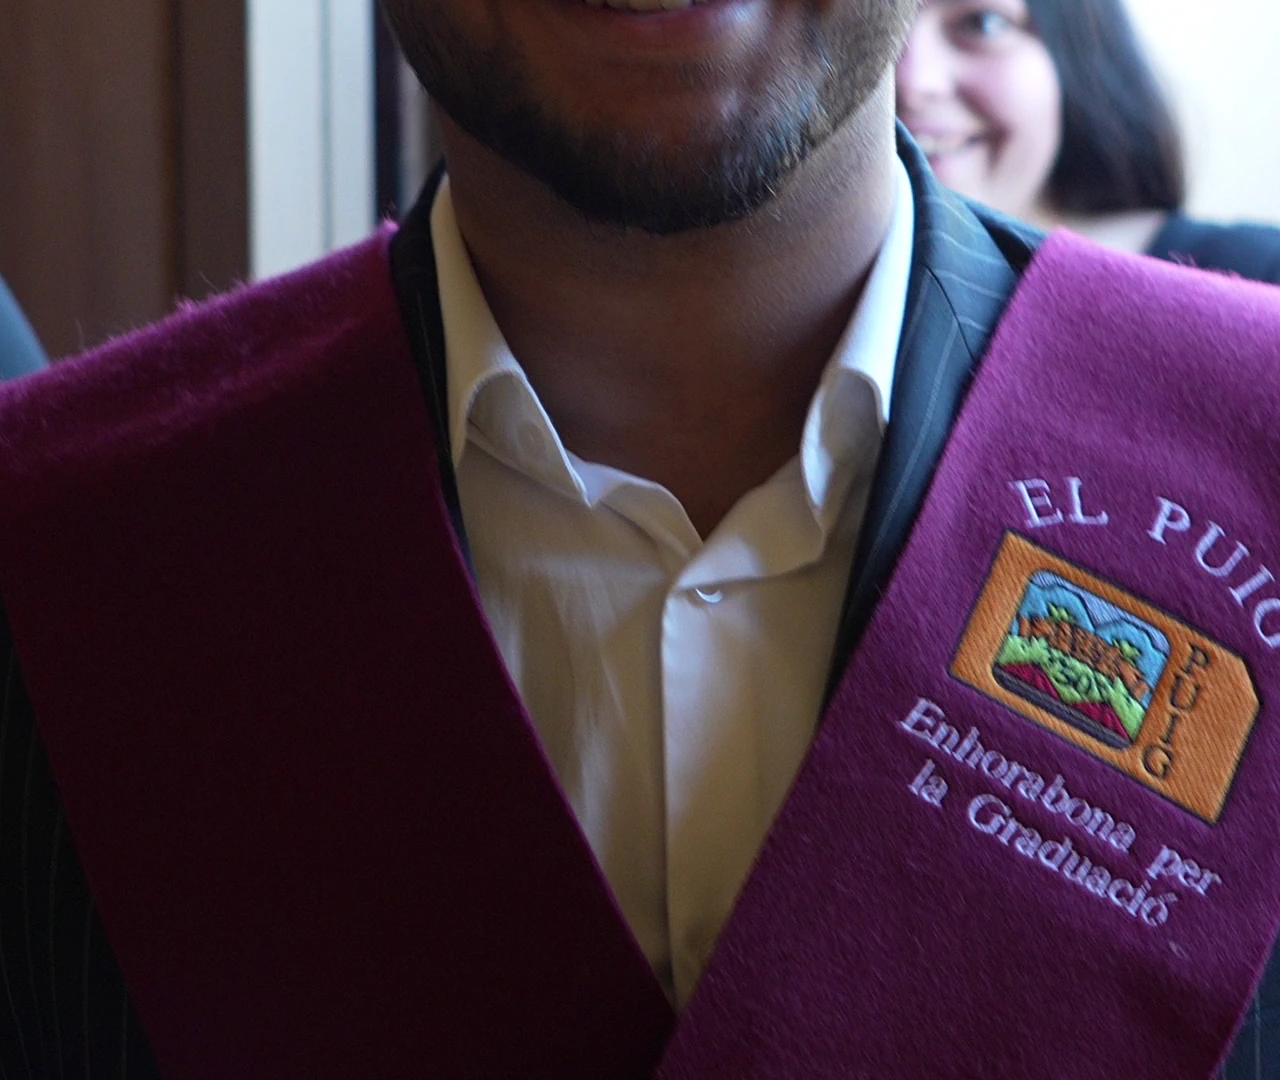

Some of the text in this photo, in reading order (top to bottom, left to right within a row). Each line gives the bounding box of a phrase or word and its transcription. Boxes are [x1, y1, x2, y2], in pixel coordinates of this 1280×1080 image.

[1009, 476, 1109, 528] EL
[1141, 644, 1209, 779] PUIG
[899, 697, 1223, 896] Enhorabona per
[907, 758, 1177, 927] la Graduació
